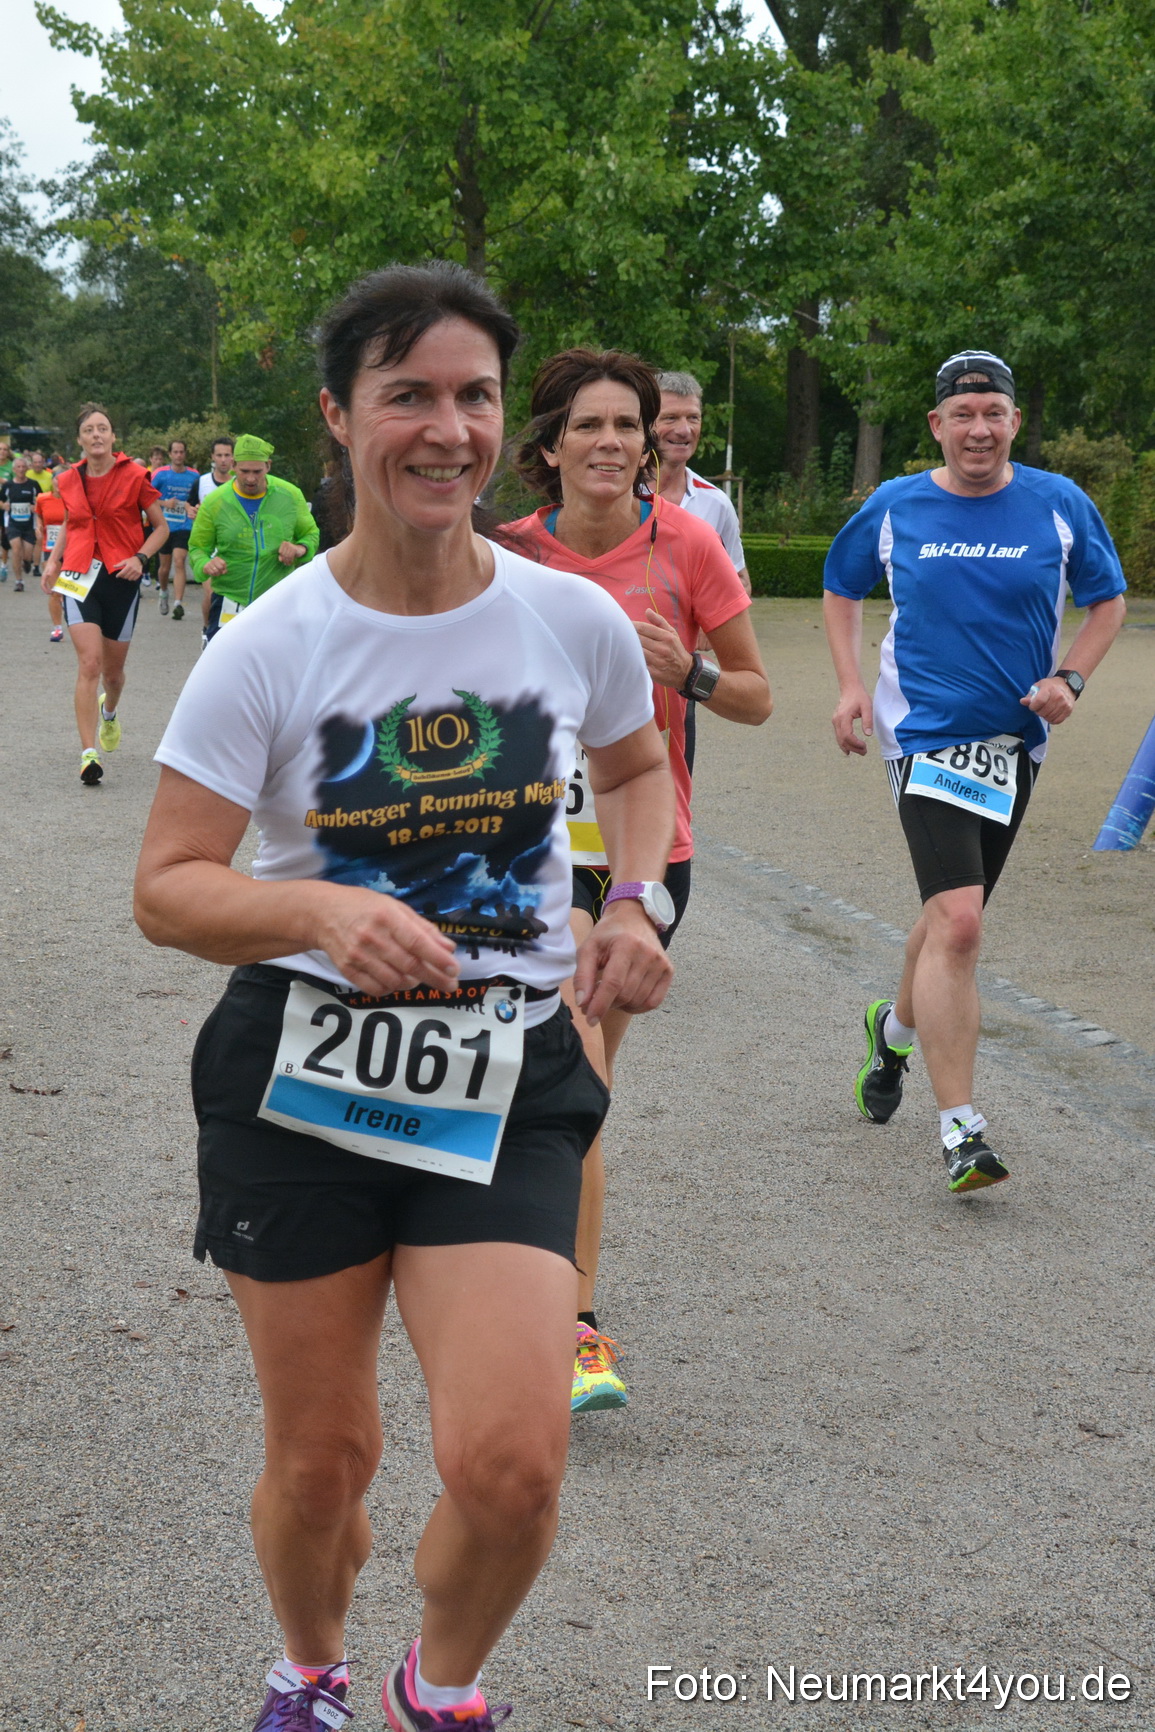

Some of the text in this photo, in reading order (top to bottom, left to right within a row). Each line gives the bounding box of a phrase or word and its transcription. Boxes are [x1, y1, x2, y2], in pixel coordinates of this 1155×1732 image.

[918, 543, 1029, 559] Ski-Club Lauf
[406, 713, 474, 753] 10.
[304, 777, 566, 829] Amberger Running Night
[934, 773, 987, 805] Andreas
[387, 816, 503, 846] 18.05.2013
[302, 1003, 491, 1100] 2061
[284, 1062, 294, 1074] B
[343, 1101, 421, 1137] Irene
[323, 1706, 339, 1720] 2061
